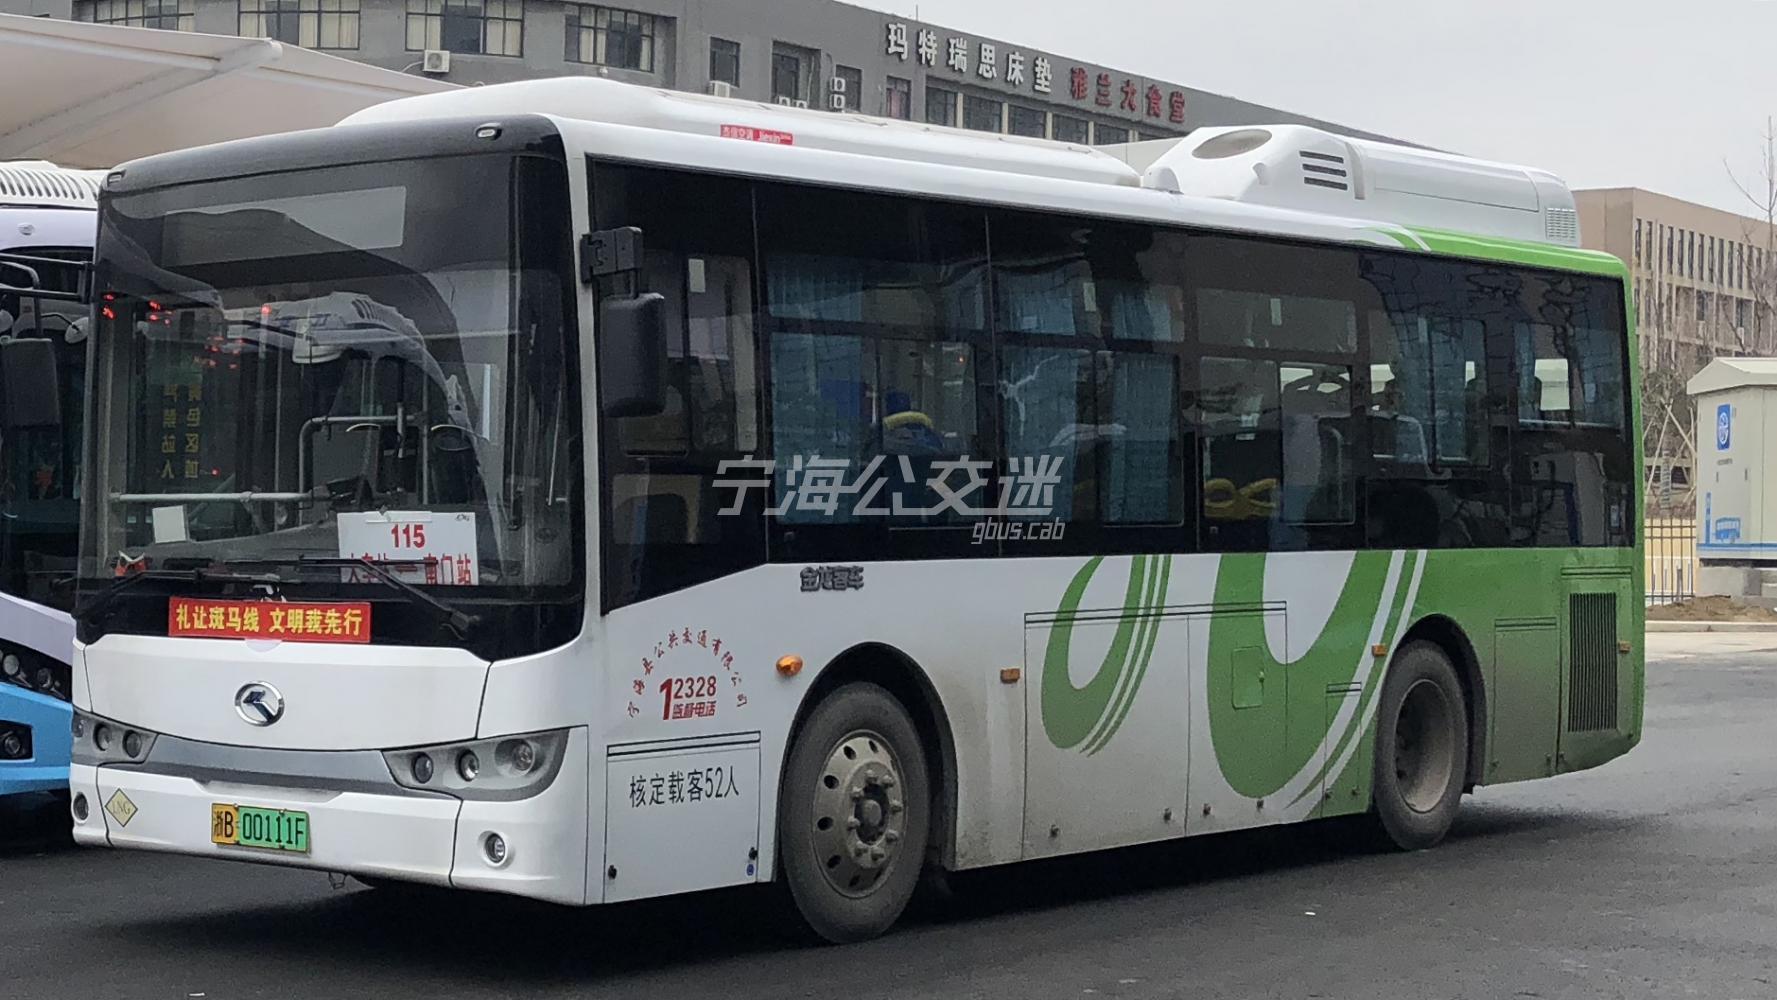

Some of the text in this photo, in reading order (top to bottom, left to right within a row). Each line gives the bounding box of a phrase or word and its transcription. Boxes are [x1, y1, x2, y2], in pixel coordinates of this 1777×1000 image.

[887, 22, 1053, 94] 玛特瑞思床垫
[391, 523, 426, 549] 115
[799, 565, 865, 593] 金龙客车
[176, 603, 363, 636] 礼让斑马线 文明我先行
[659, 675, 717, 721] 12328
[629, 765, 739, 808] 核定载客52人
